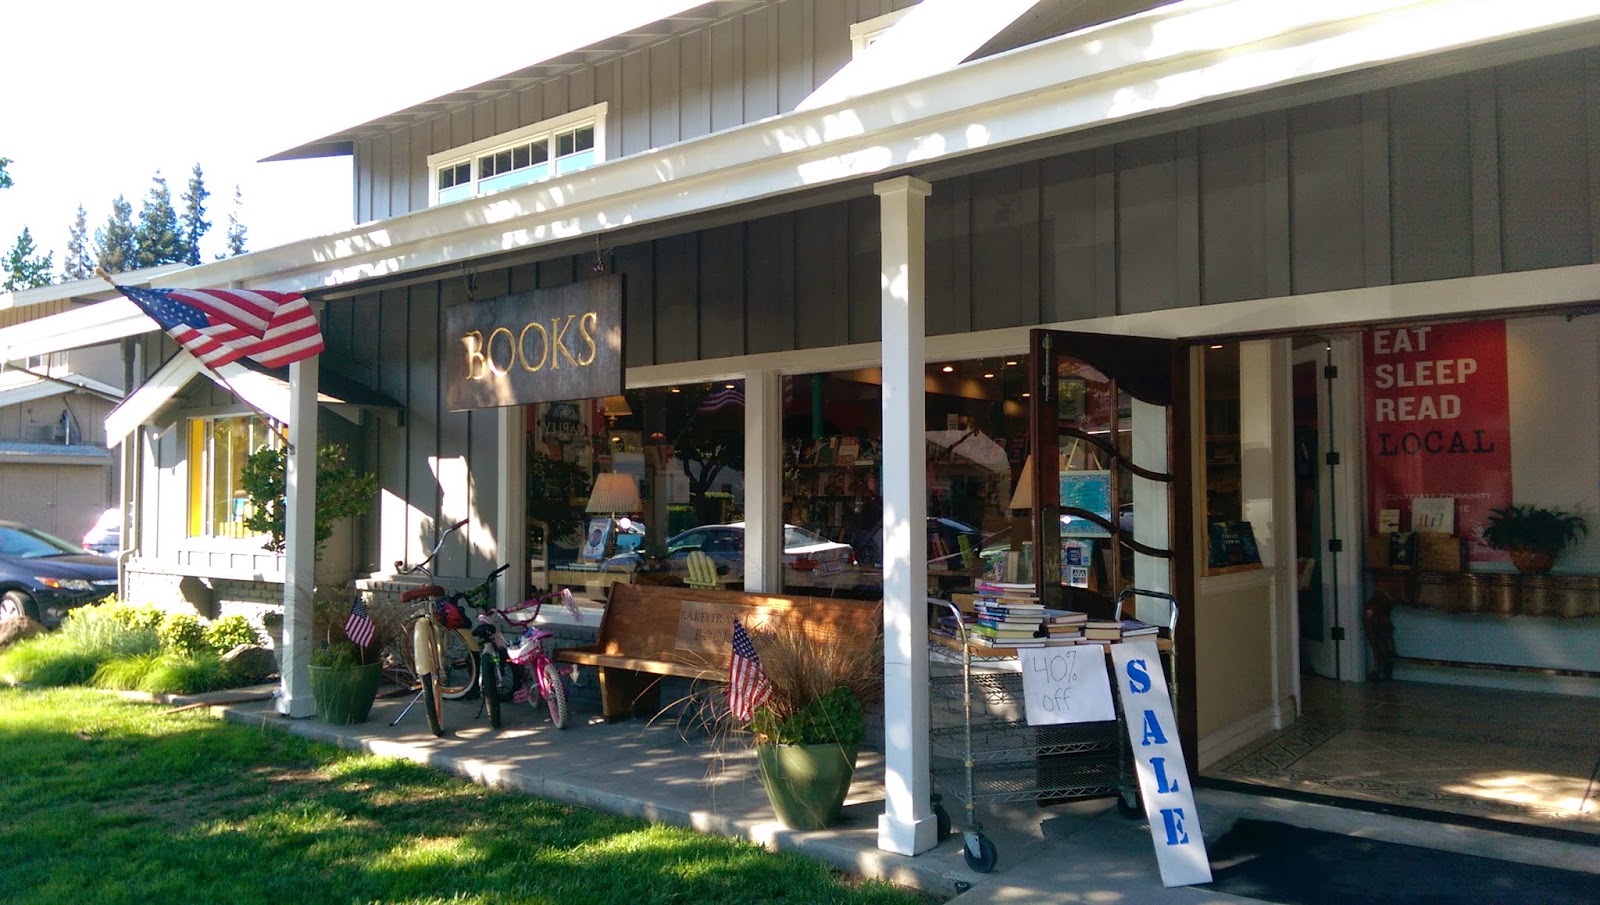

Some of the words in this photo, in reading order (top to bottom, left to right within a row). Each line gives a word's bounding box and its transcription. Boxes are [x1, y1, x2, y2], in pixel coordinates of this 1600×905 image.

[465, 311, 598, 380] BOOKS
[1374, 326, 1431, 354] EAT
[1375, 358, 1477, 389] SLEEP
[1375, 394, 1461, 422] READ
[1378, 429, 1496, 456] LOCAL
[680, 610, 732, 625] RAKESTRA
[694, 628, 731, 643] BOOK
[1033, 650, 1078, 683] 40%
[1126, 659, 1189, 846] SALE
